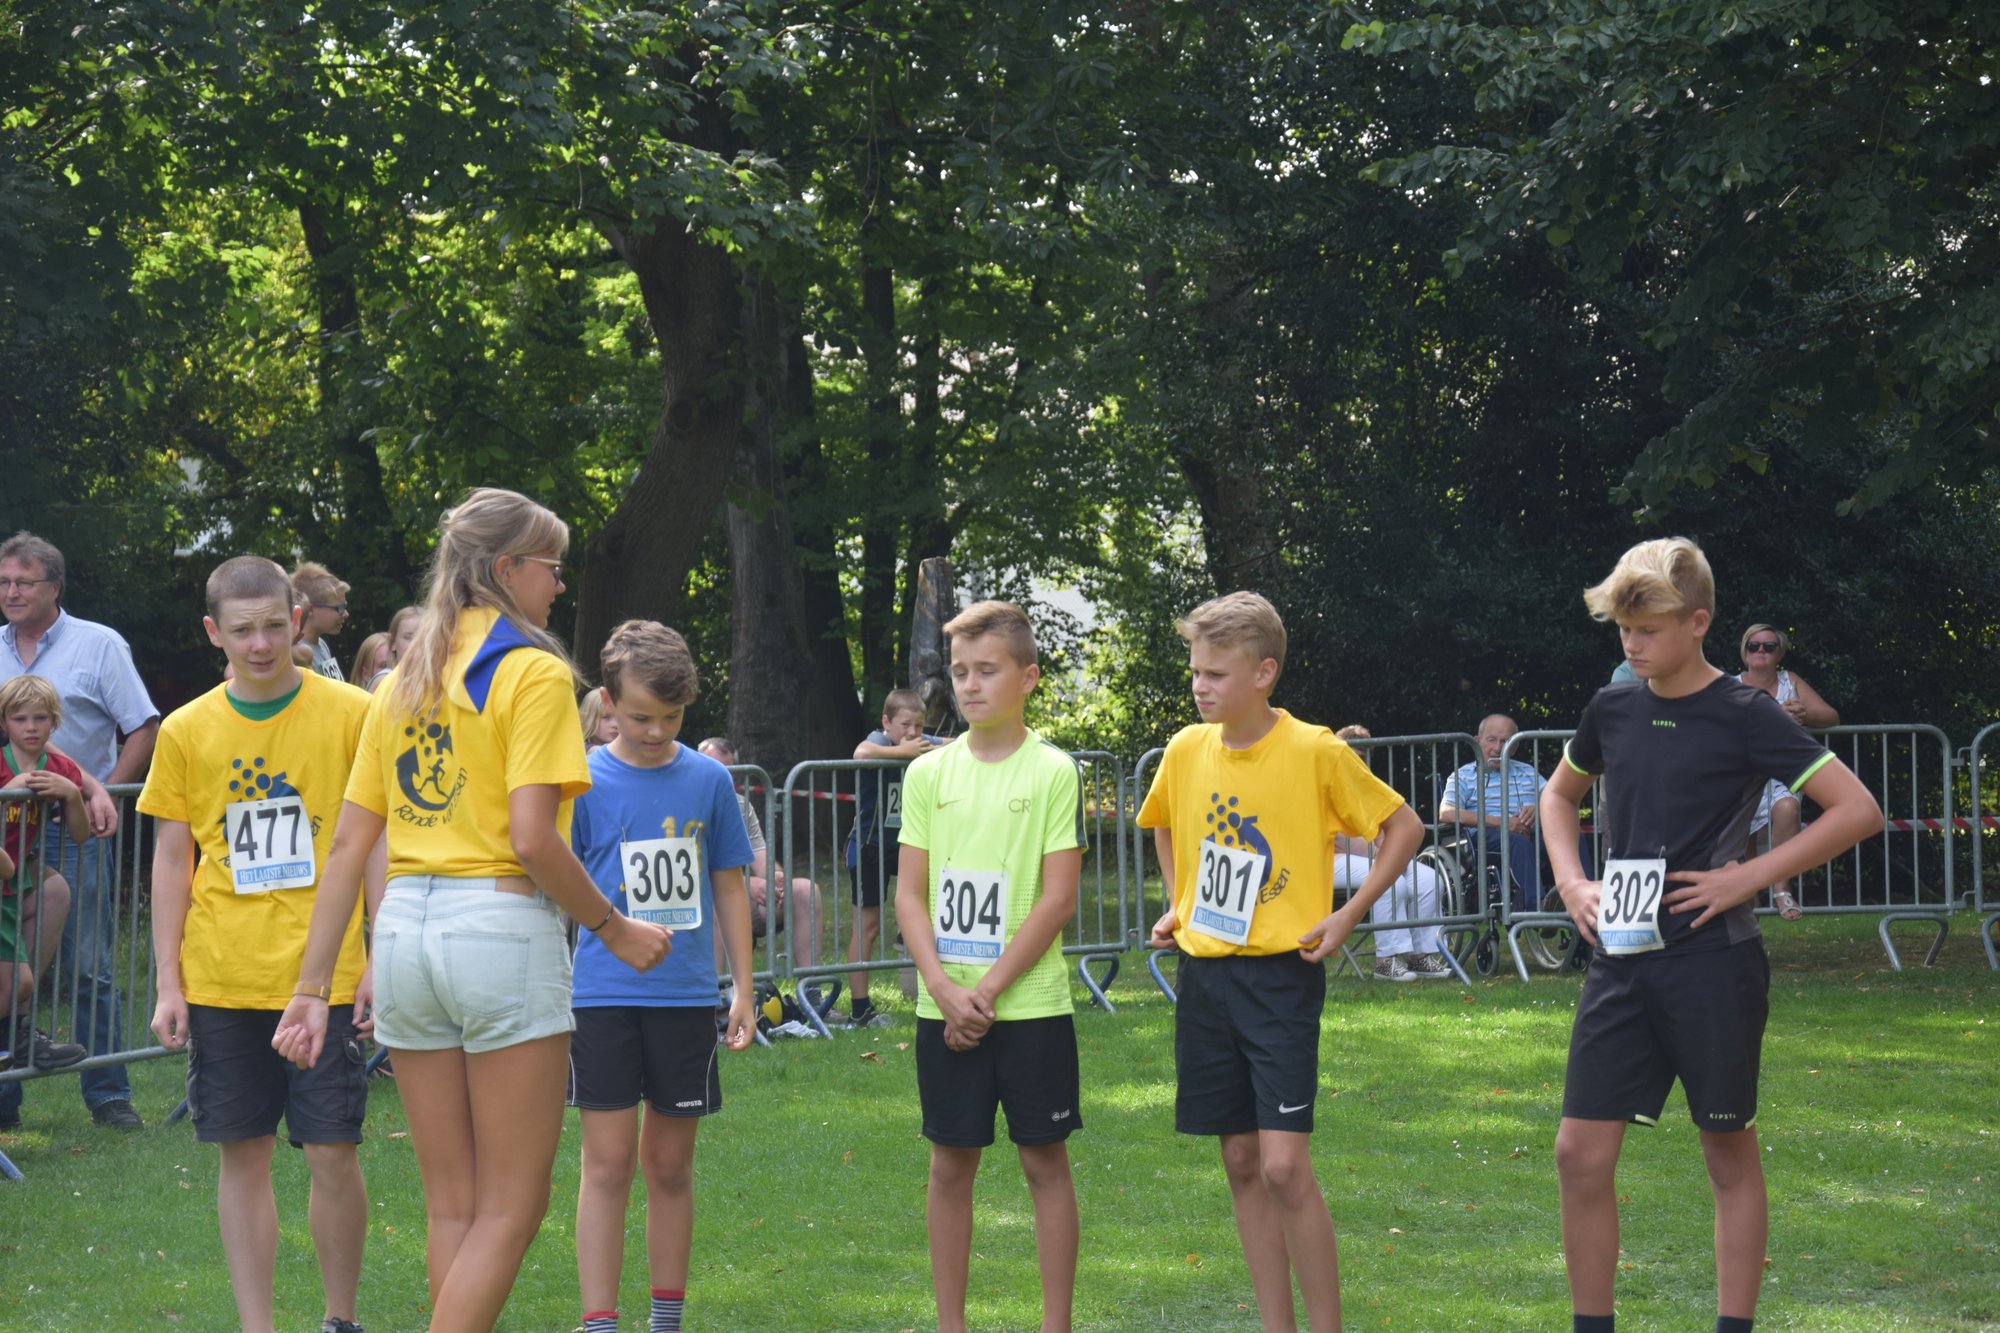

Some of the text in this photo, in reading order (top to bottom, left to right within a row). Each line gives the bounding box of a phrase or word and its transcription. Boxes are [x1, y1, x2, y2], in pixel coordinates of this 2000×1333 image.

[234, 804, 301, 861] 477
[393, 804, 438, 828] Ronde
[240, 864, 308, 883] HET LAATSTE NIEUWS
[629, 848, 694, 903] 303
[1201, 849, 1253, 912] 301
[1259, 867, 1291, 904] Essen
[648, 911, 671, 923] LAATSTE
[672, 909, 694, 922] NIEUWS
[940, 878, 1001, 936] 304
[1604, 869, 1660, 925] 302
[948, 940, 972, 956] LAATSTE
[972, 942, 997, 957] NIEUWS
